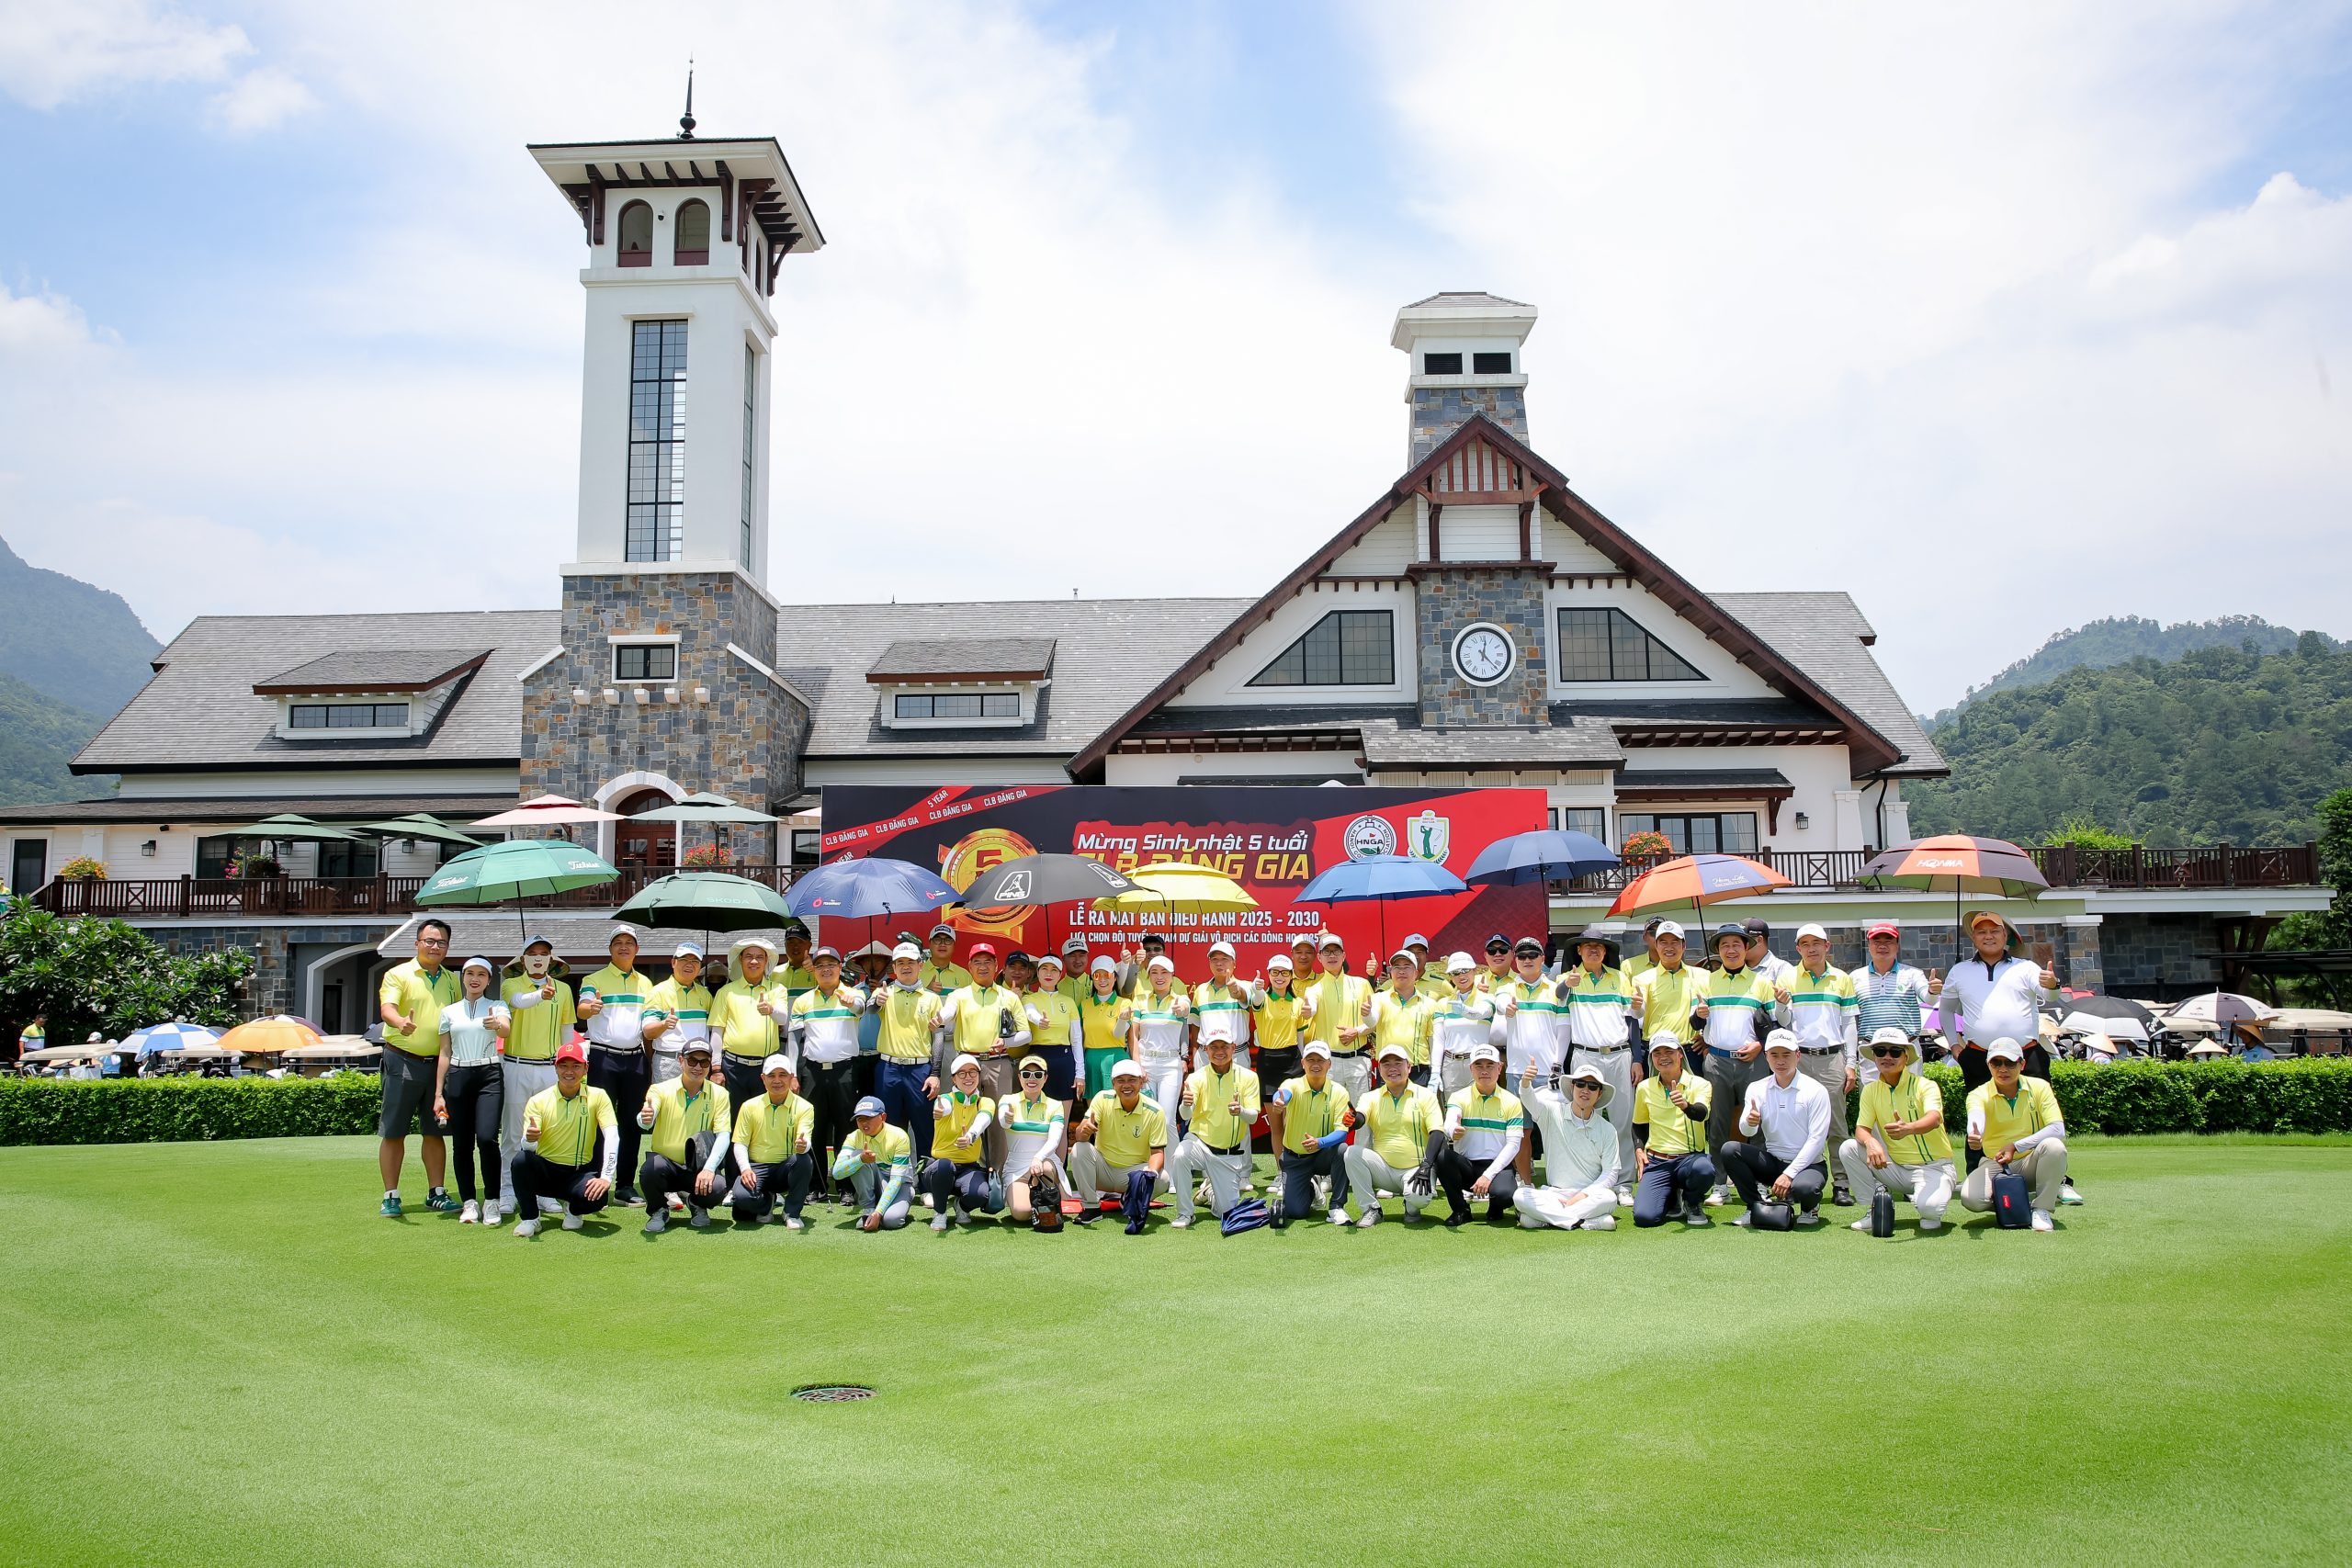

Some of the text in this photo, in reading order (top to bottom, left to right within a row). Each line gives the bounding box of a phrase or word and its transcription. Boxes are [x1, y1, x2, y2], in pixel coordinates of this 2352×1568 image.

[927, 789, 949, 808] 5 YEAR
[983, 797, 997, 807] CLB
[1015, 789, 1028, 799] GIA
[929, 809, 942, 820] CLB
[962, 802, 973, 812] GIA
[875, 824, 888, 834] CLB
[908, 816, 920, 826] GIA
[825, 835, 838, 846] CLB
[858, 829, 869, 838] GIA
[1077, 830, 1308, 854] Mừng Sinh nhật 5 tuổi
[1255, 853, 1309, 880] GIA
[1917, 859, 1963, 868] HONMA
[999, 891, 1025, 899] PING
[1069, 902, 1085, 925] LỄ
[1088, 912, 1106, 925] RA
[1139, 912, 1165, 926] BAN
[1239, 911, 1272, 926] 2025
[1287, 911, 1319, 926] 2030
[1088, 932, 1110, 945] CHỌN
[1179, 931, 1192, 945] DỰ
[1193, 930, 1208, 942] GIẢI
[1243, 930, 1259, 942] CÁC
[1261, 930, 1283, 942] DÒNG
